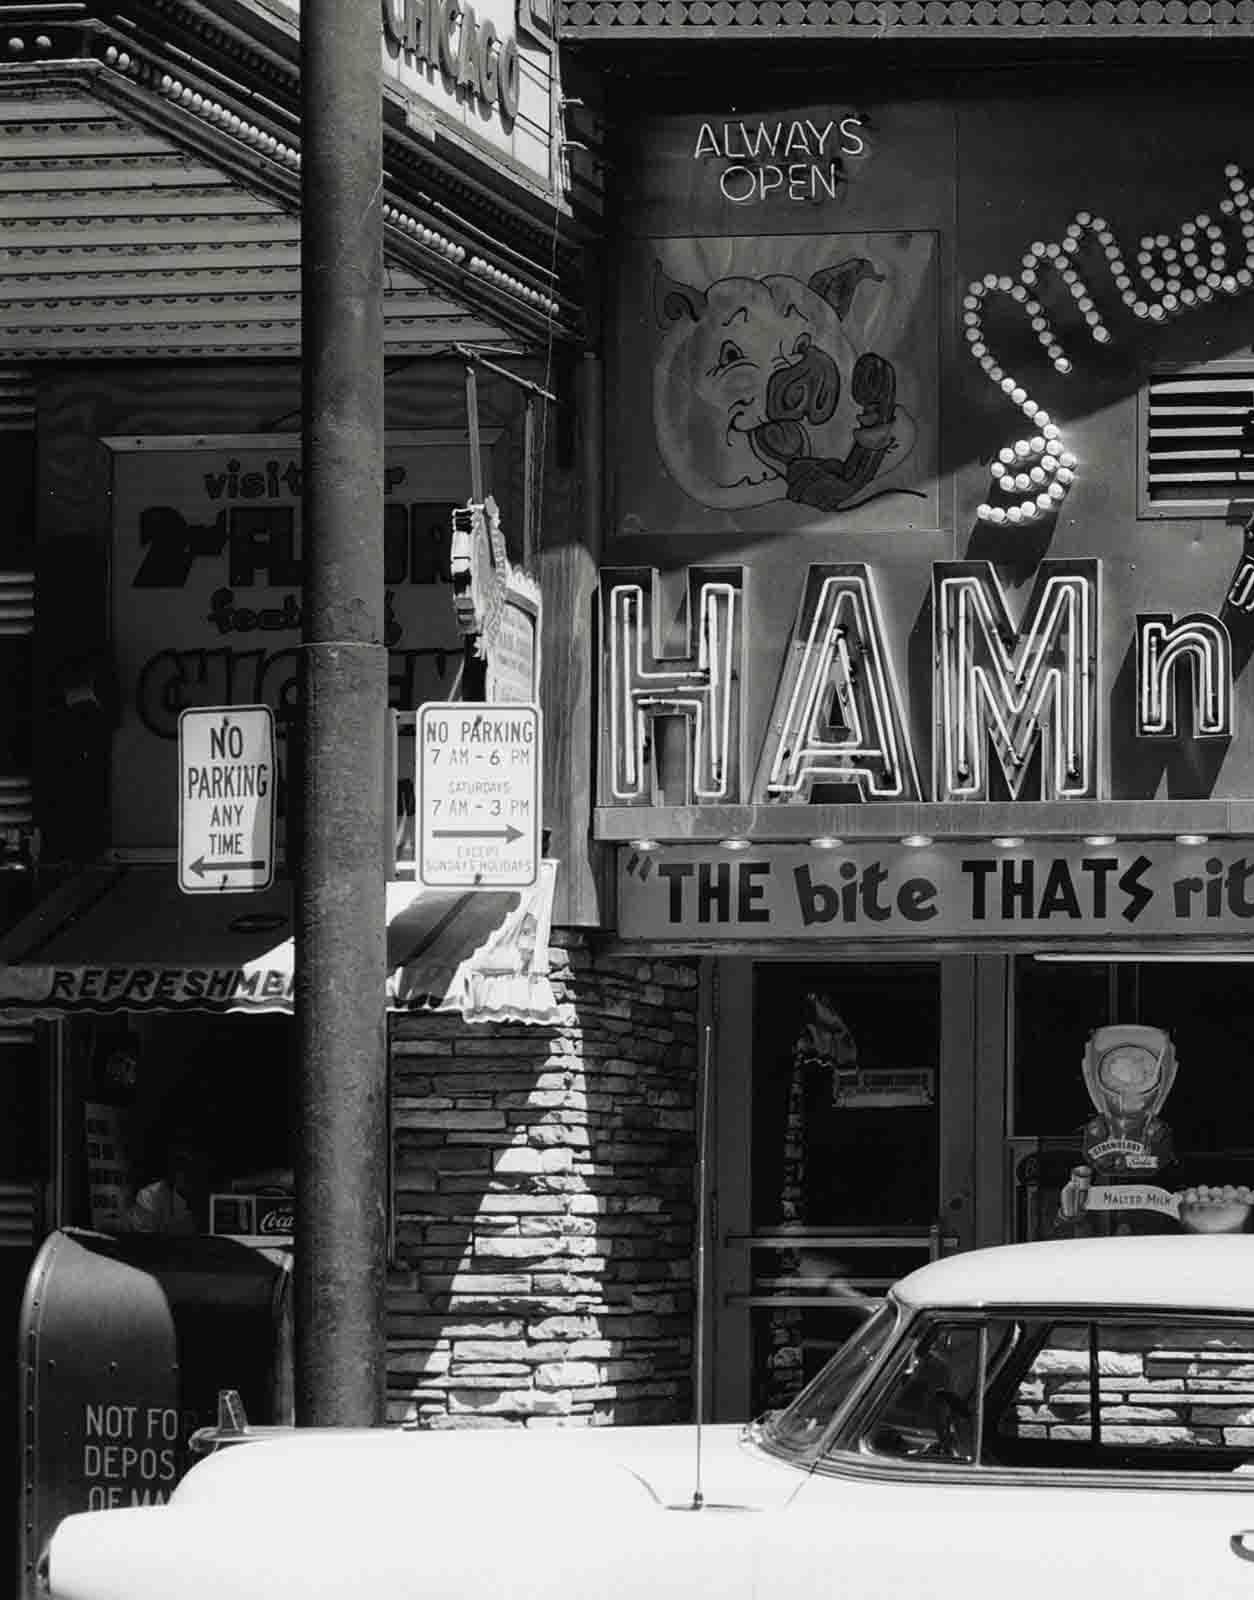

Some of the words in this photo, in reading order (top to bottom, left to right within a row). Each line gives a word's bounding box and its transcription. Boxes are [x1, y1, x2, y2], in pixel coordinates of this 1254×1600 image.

[692, 116, 867, 161] ALWAYS
[718, 163, 838, 202] OPEN
[598, 558, 1106, 802] HAM
[209, 725, 244, 761] NO
[425, 720, 449, 744] NO
[460, 720, 534, 744] PARKING
[431, 748, 441, 766] 7
[449, 748, 470, 766] AM
[489, 748, 501, 766] 6
[511, 748, 530, 766] PM
[187, 763, 269, 801] PARKING
[448, 780, 512, 796] SATURDAYS
[209, 804, 245, 828] ANY
[431, 799, 442, 817] 7
[450, 799, 470, 817] AM
[489, 799, 501, 817] 3
[511, 799, 530, 817] PM
[207, 831, 245, 857] TIME
[792, 861, 939, 927] bite
[961, 854, 1154, 924] THATS
[50, 968, 295, 1000] REFRESHME
[84, 1403, 138, 1439] NOT
[146, 1407, 178, 1441] FO
[83, 1444, 176, 1481] DEPOS
